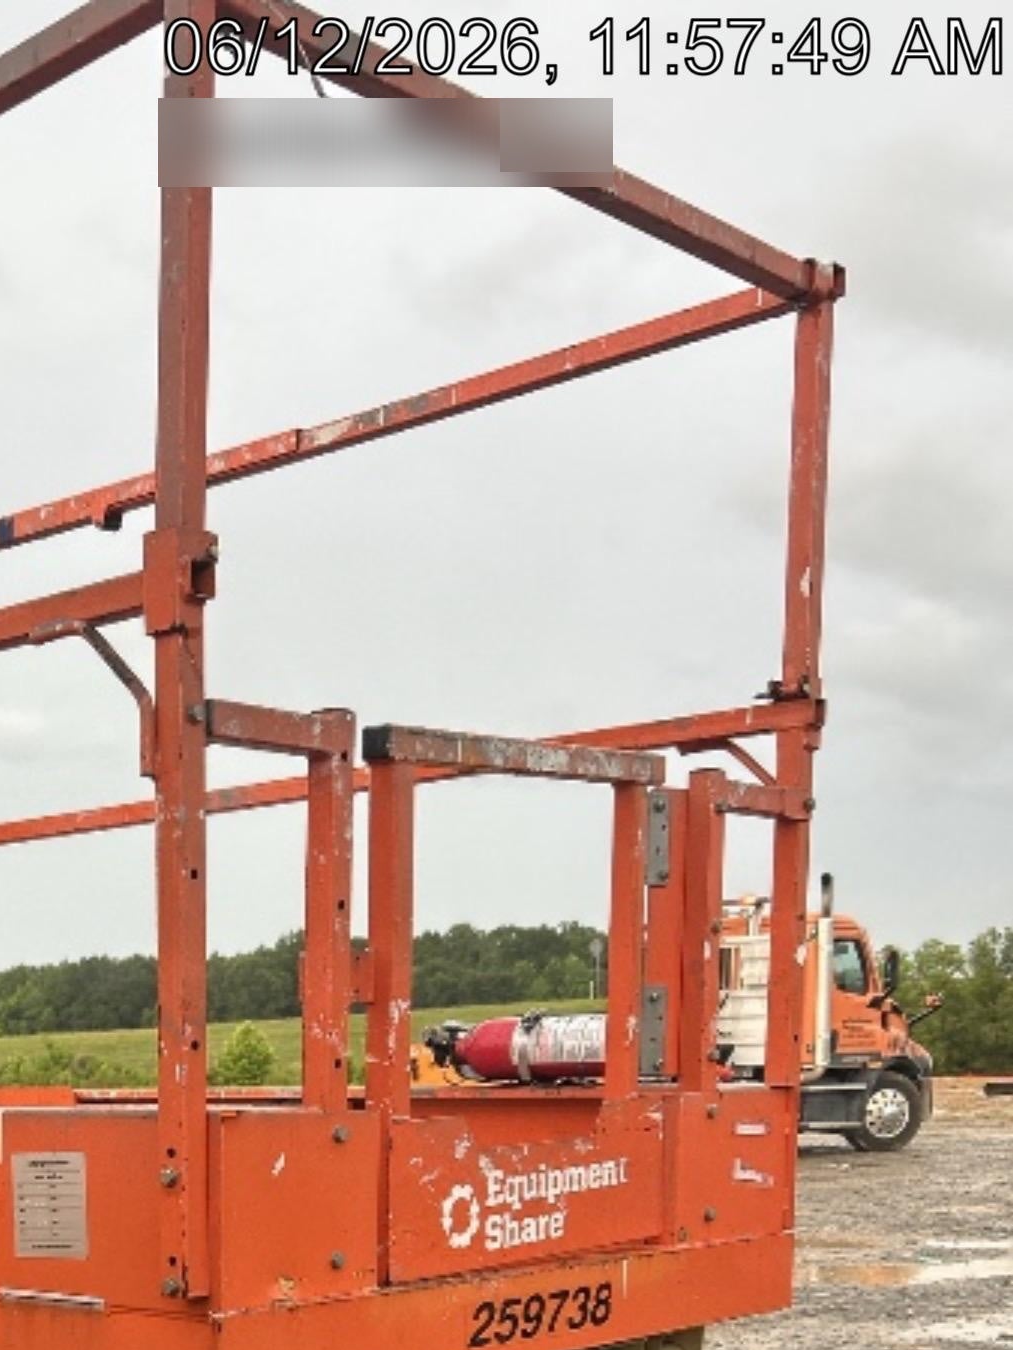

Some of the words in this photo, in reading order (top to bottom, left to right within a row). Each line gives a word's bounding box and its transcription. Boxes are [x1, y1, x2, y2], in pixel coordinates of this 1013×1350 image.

[485, 1157, 628, 1210] Equipment
[485, 1212, 565, 1251] Share
[467, 1281, 614, 1349] 259738
